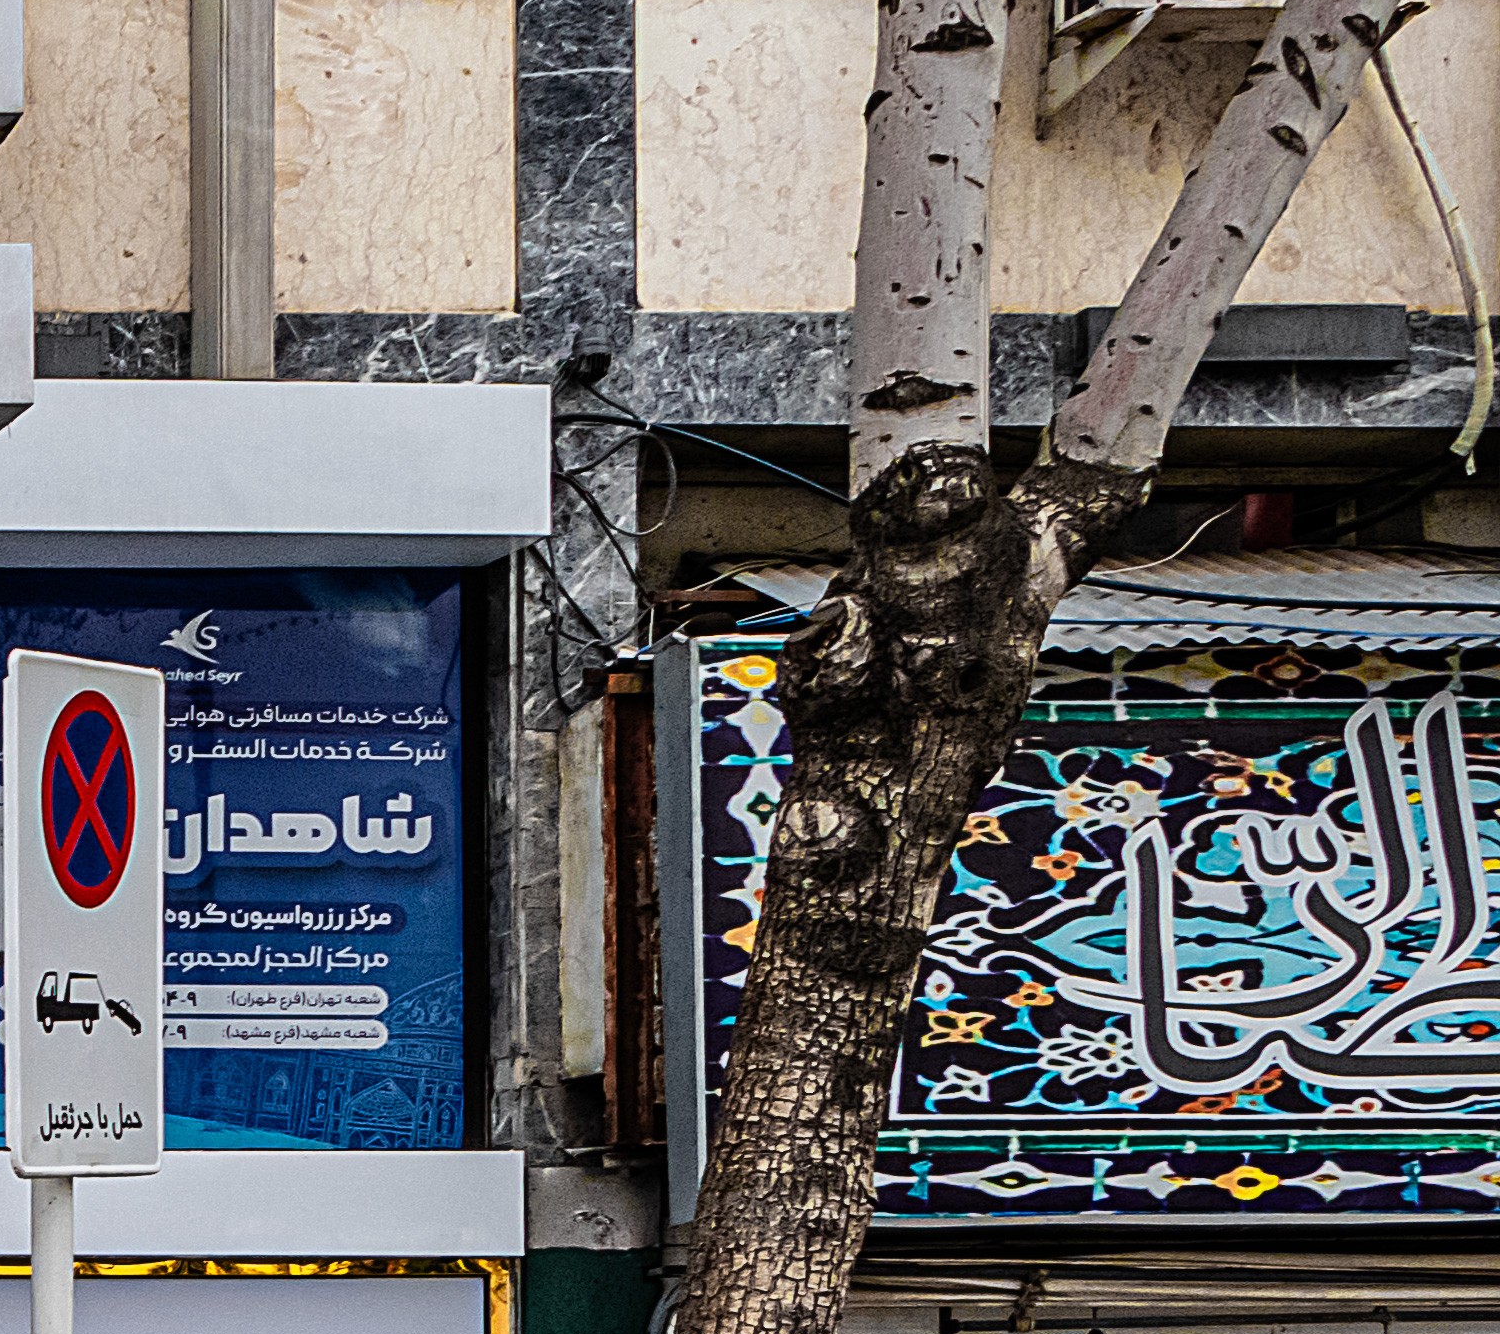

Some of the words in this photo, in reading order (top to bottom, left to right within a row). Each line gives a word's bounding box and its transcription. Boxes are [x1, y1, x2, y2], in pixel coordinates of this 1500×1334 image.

[165, 668, 206, 682] ahed
[207, 668, 244, 685] Seyr
[228, 703, 313, 729] مسافرتی
[316, 704, 388, 728] خدمات
[391, 704, 449, 729] شرکت
[168, 743, 184, 764] و
[187, 737, 266, 766] السفر
[269, 737, 353, 762] خدمات
[163, 792, 433, 875] شاهدان
[164, 902, 228, 930] گروه
[230, 904, 344, 932] رزرواسیون
[344, 903, 392, 932] مرکز
[163, 944, 261, 973] لمجموع
[263, 944, 323, 974] الحجز
[343, 992, 382, 1007] شعبه
[342, 1025, 381, 1040] شعبه
[39, 1102, 94, 1142] جرثقیل
[96, 1102, 108, 1138] با
[112, 1102, 144, 1141] حمل
